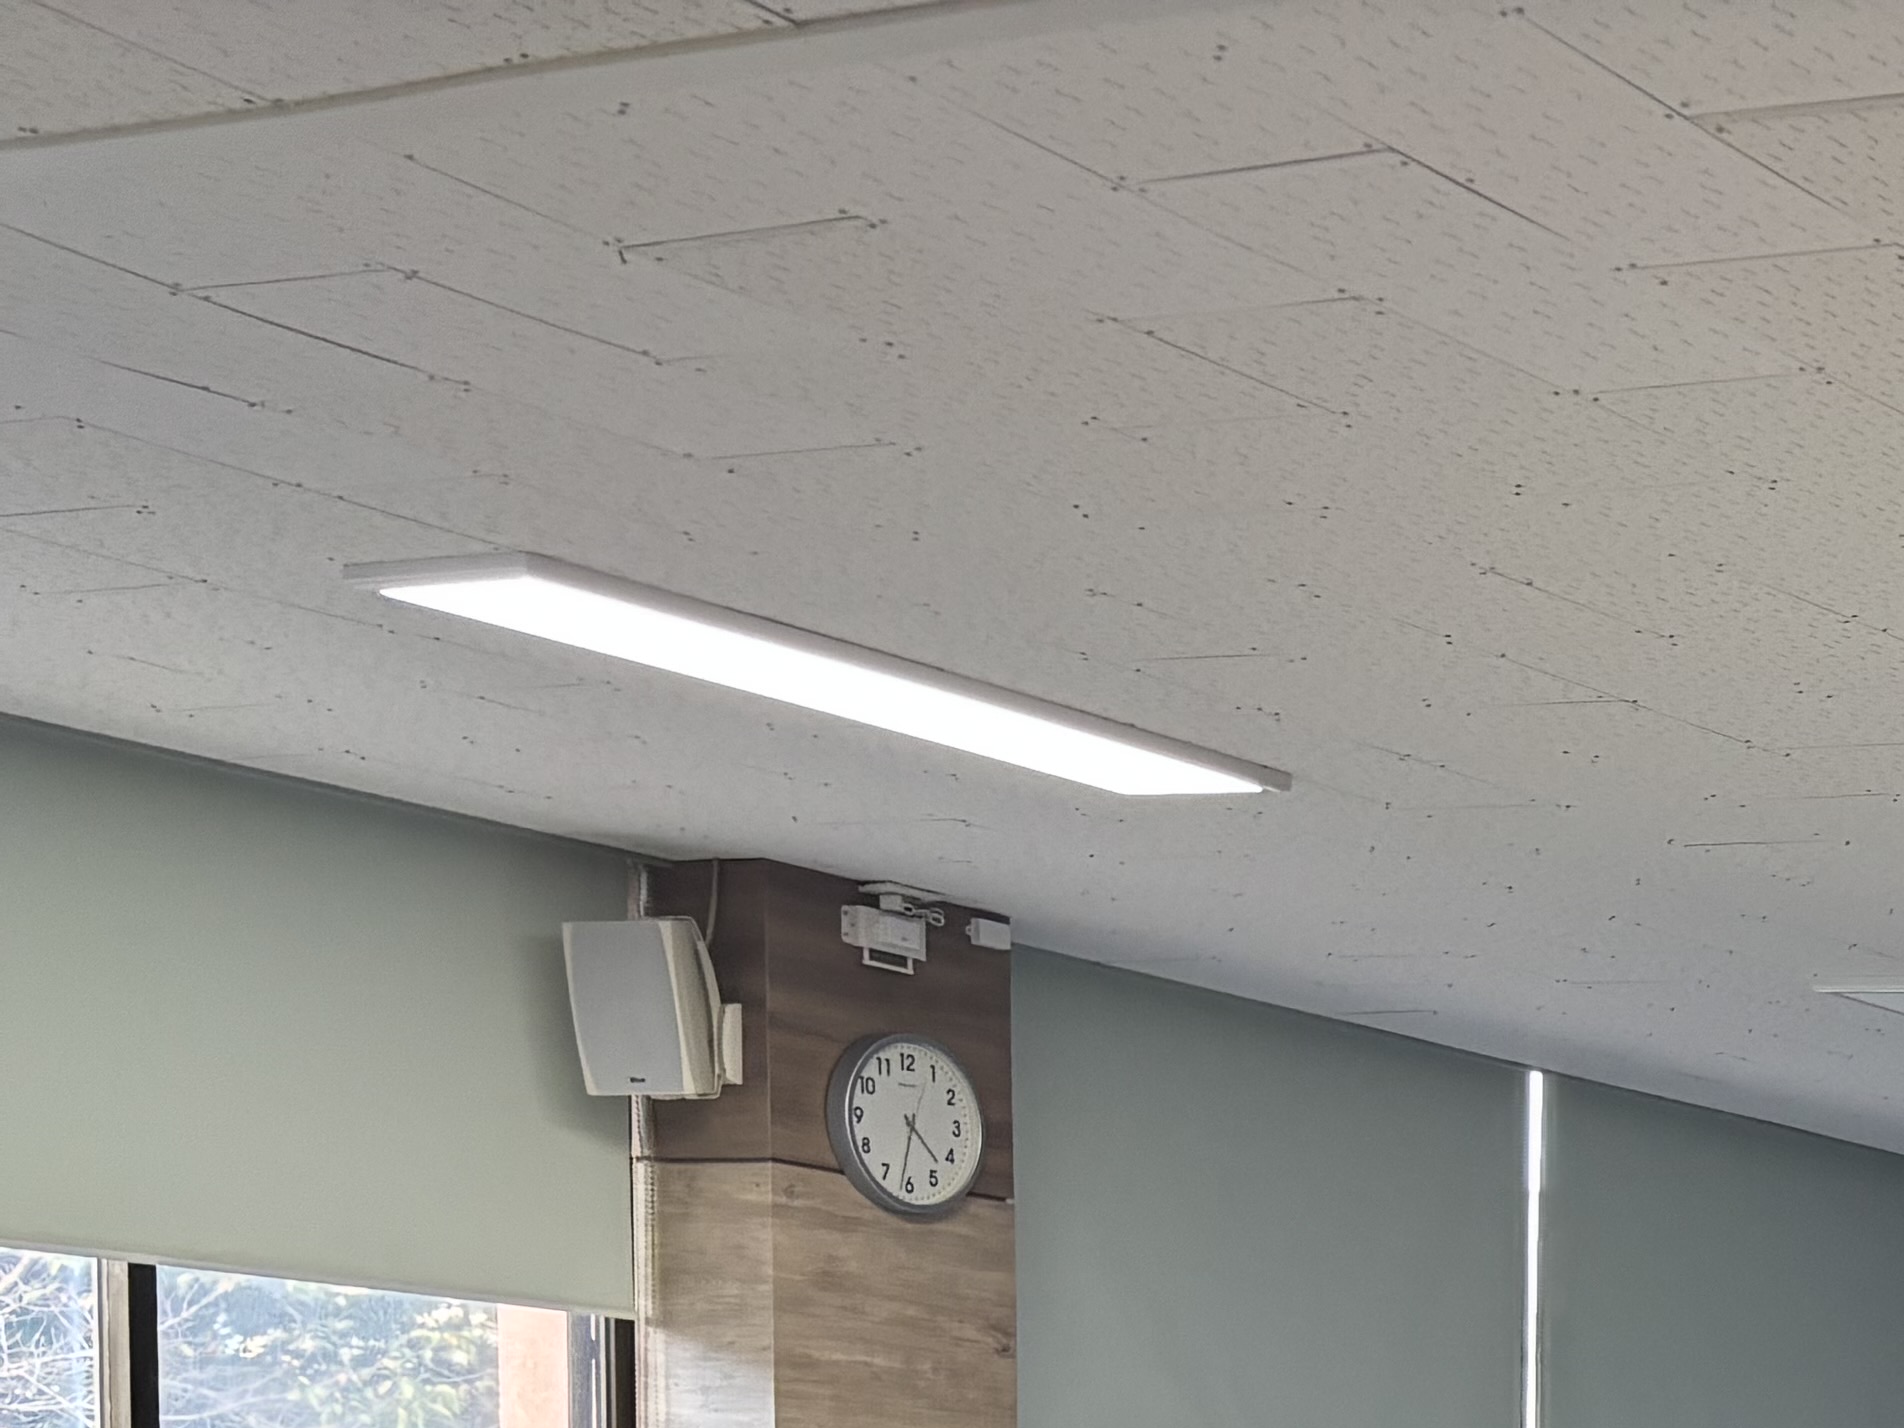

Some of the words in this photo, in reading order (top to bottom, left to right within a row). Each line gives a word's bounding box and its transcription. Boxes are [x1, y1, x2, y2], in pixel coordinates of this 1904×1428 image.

[876, 1057, 890, 1076] 11
[900, 1053, 915, 1071] 12
[930, 1065, 936, 1083] 1
[859, 1076, 875, 1095] 10
[946, 1089, 955, 1106] 2
[854, 1106, 864, 1124] 9
[952, 1120, 961, 1137] 3
[861, 1137, 871, 1153] 8
[945, 1148, 955, 1164] 4
[881, 1163, 890, 1180] 7
[929, 1170, 938, 1187] 5
[905, 1176, 914, 1194] 6
